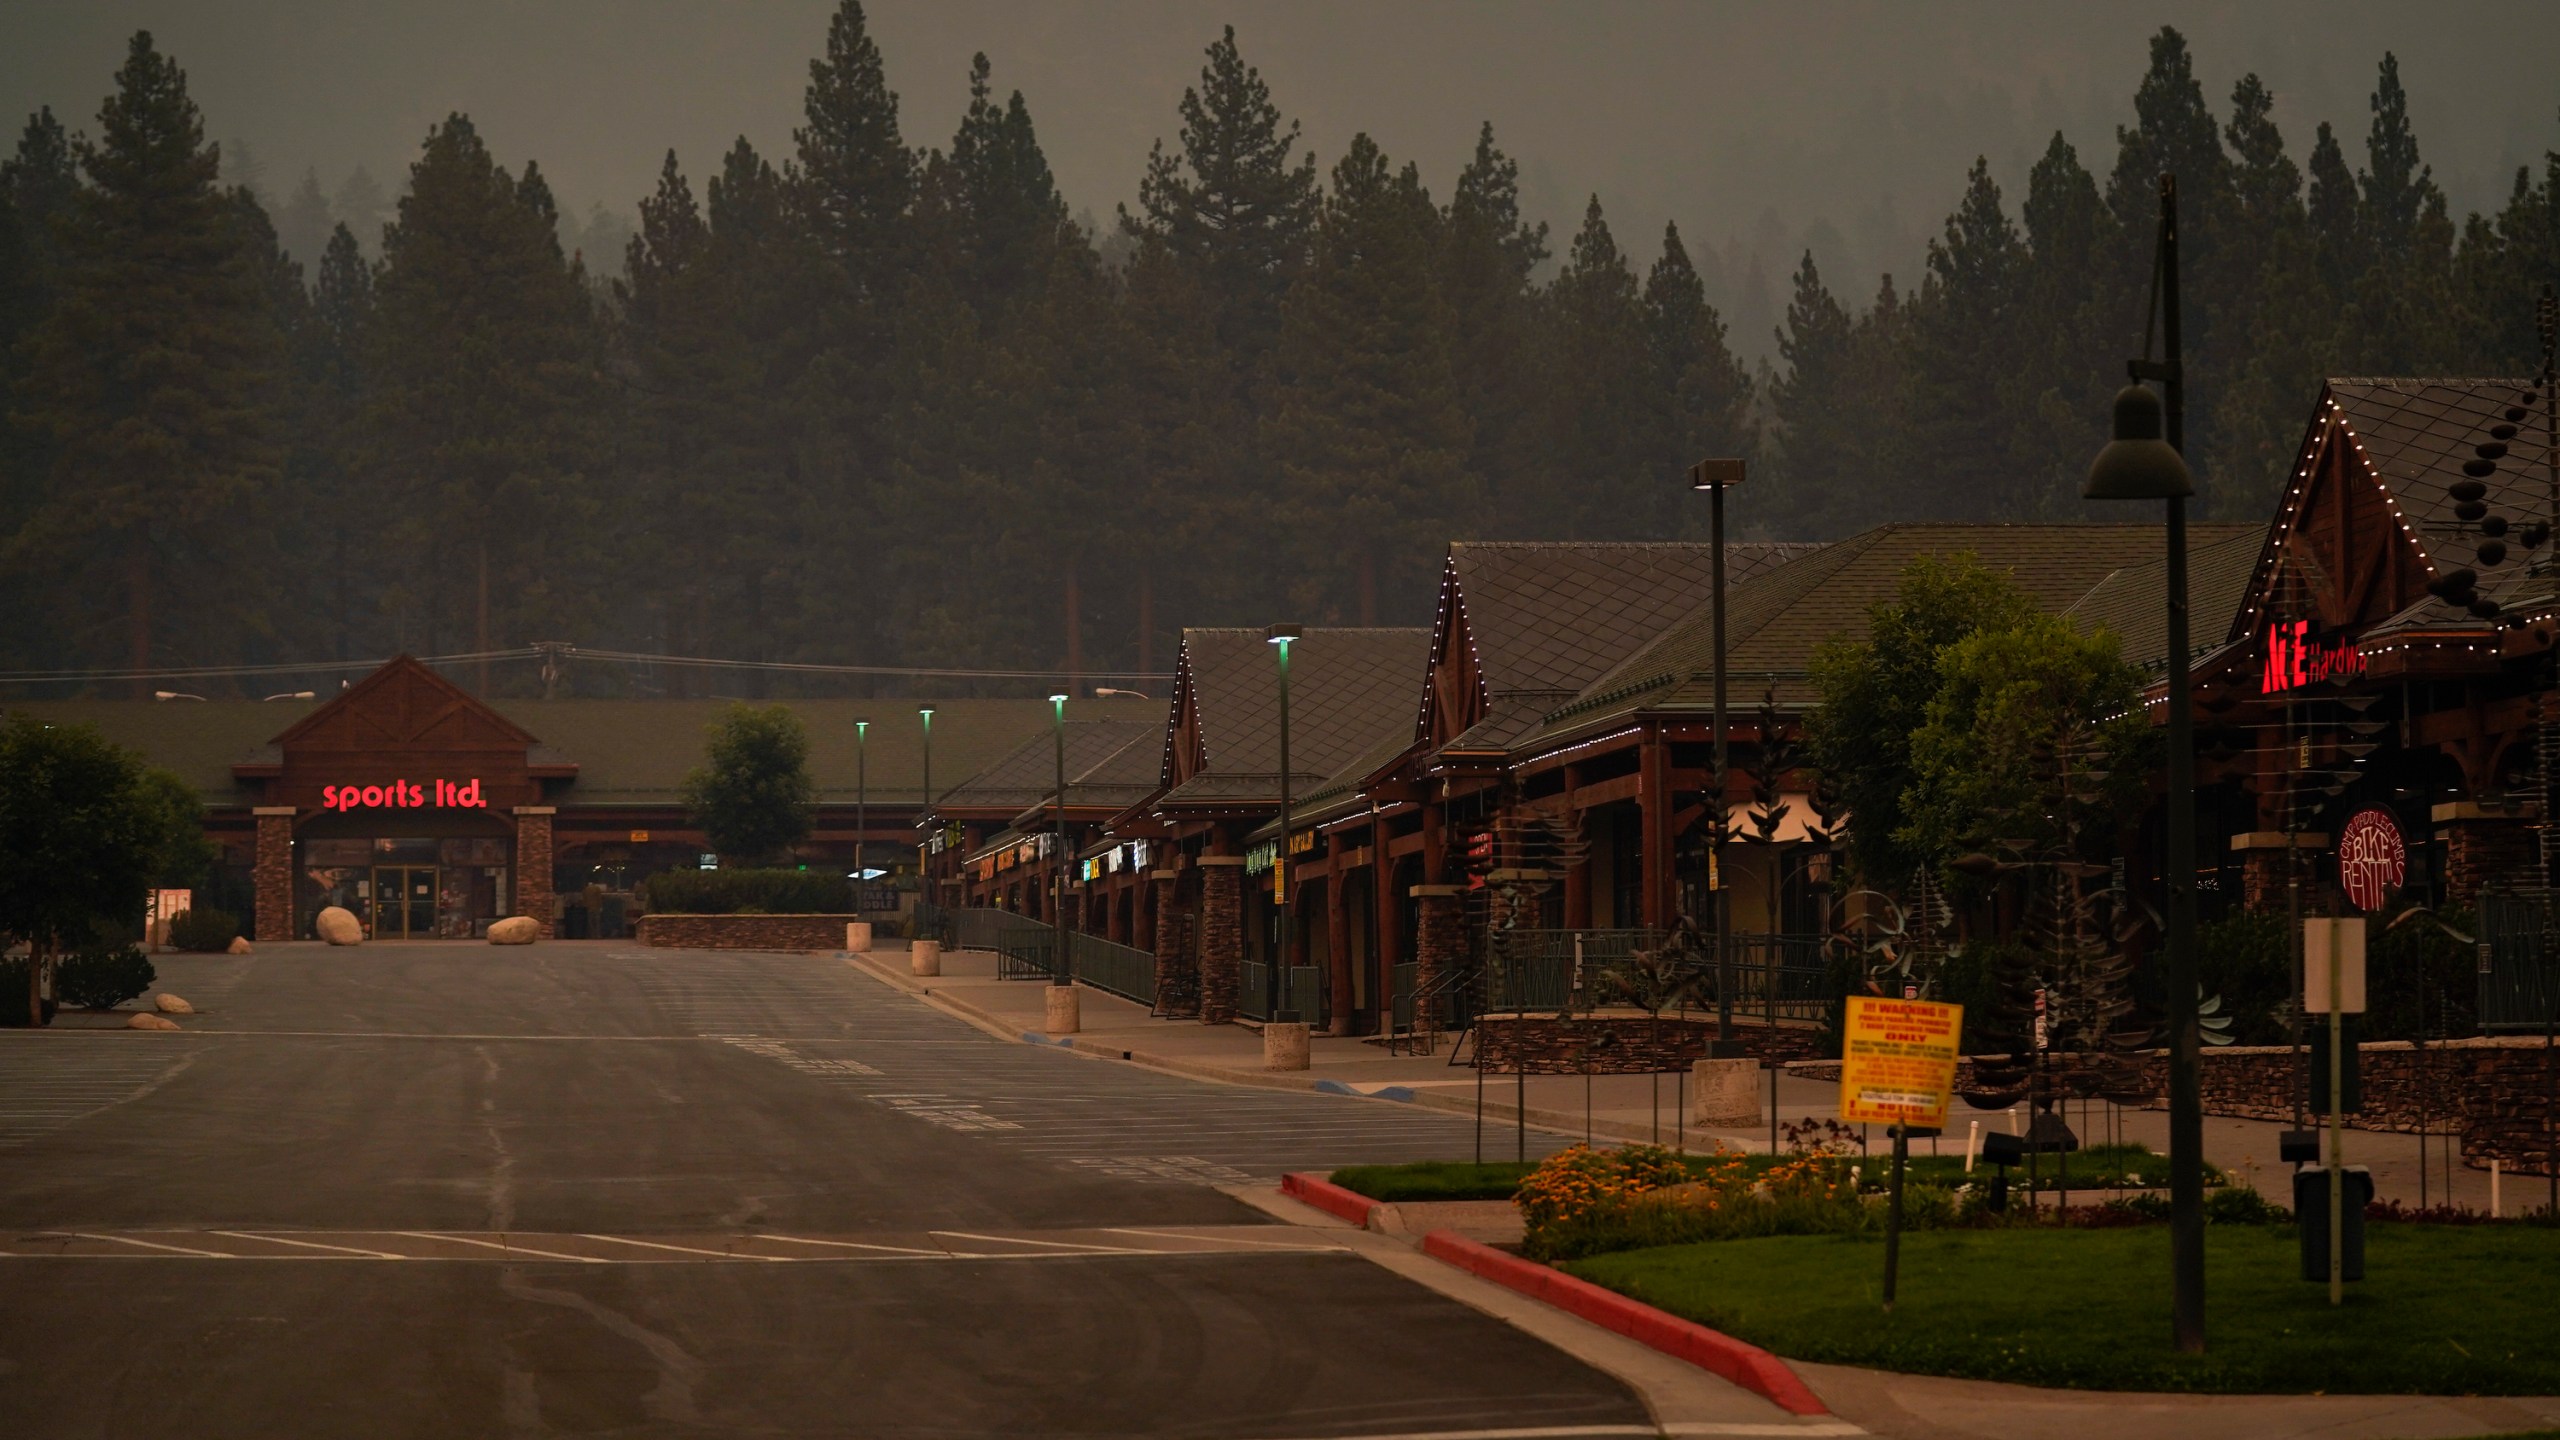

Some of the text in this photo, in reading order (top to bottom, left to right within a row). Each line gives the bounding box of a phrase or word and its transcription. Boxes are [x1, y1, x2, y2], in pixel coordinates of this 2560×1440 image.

[322, 778, 487, 812] sports ltd.
[2352, 827, 2391, 862] BIKE
[1879, 1003, 1936, 1017] WARNING
[1885, 1032, 1926, 1042] ONLY
